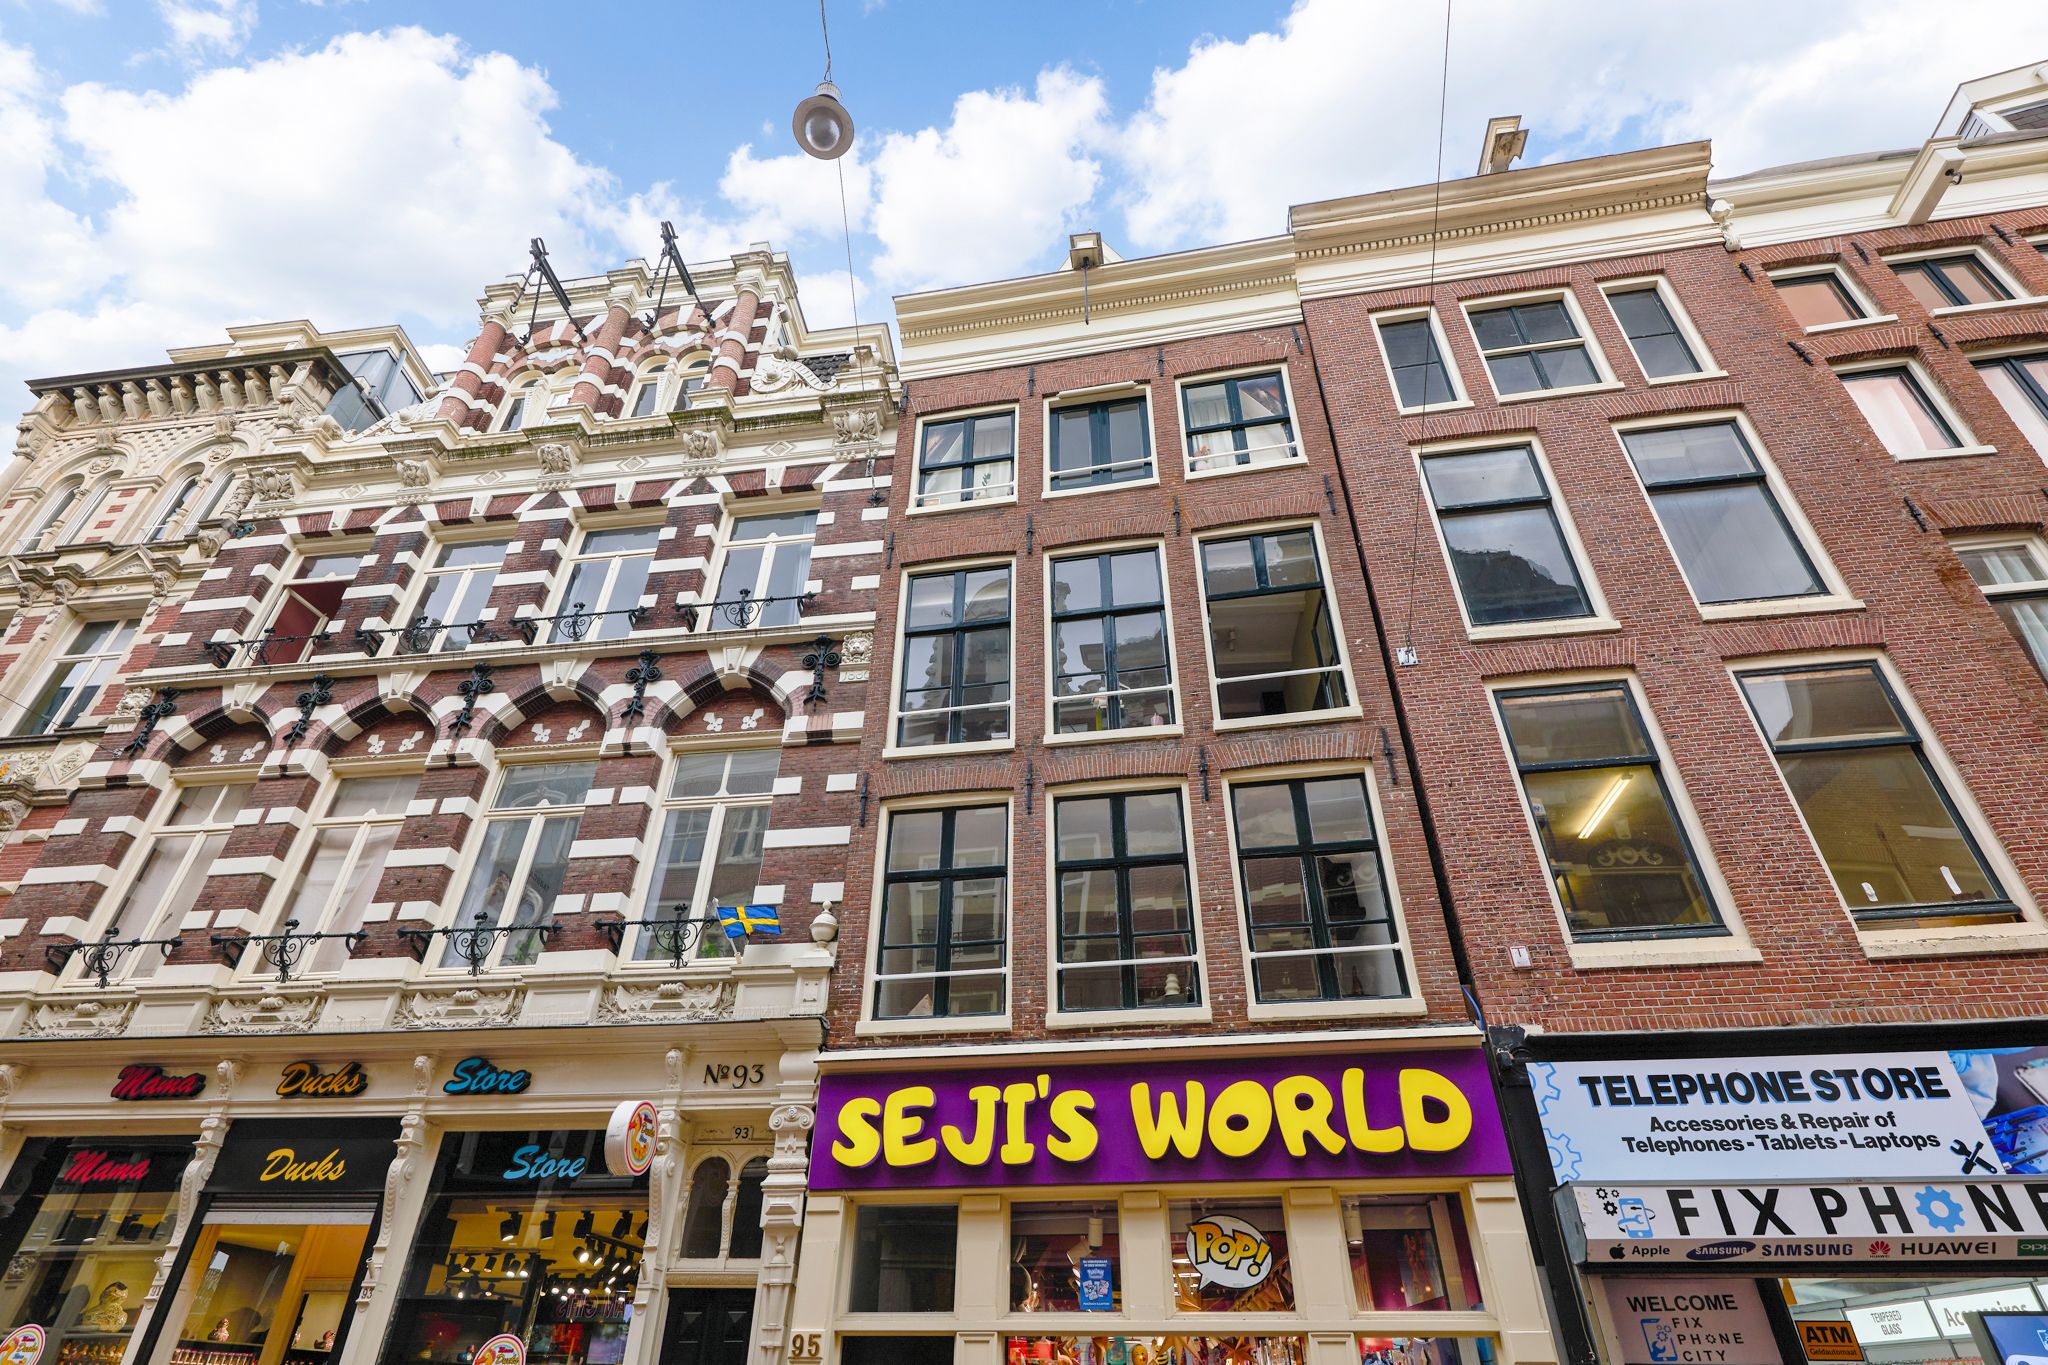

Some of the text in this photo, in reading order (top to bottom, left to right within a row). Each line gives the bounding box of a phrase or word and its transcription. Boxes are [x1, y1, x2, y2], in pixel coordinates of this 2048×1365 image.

[112, 1057, 530, 1099] Mama Ducks Store
[1579, 1066, 1951, 1107] TELEPHONE STORE
[832, 1068, 1473, 1168] SEJI'S WORLD
[1650, 1111, 1897, 1133] Accessories & Repair of
[735, 1127, 749, 1139] 93
[64, 1151, 150, 1183] Mama
[260, 1148, 346, 1181] Ducks
[503, 1145, 586, 1179] Store
[1666, 1188, 1796, 1236] FIX
[1187, 1222, 1271, 1277] POP!
[1632, 1245, 1748, 1257] Apple SAMSUNG
[1762, 1243, 1853, 1257] SAMSUNG
[1901, 1241, 1996, 1255] HUAWEI
[361, 1287, 374, 1299] 93
[1626, 1294, 1738, 1312] WELCOME
[1672, 1317, 1703, 1328] FIX
[1870, 1310, 1902, 1323] TEMPERED
[1806, 1326, 1853, 1343] ATM
[1880, 1323, 1903, 1335] GLASS
[791, 1333, 822, 1357] 95
[1677, 1332, 1744, 1344] PHONE
[1683, 1350, 1726, 1361] CITY
[1809, 1347, 1858, 1356] Geldautomaat
